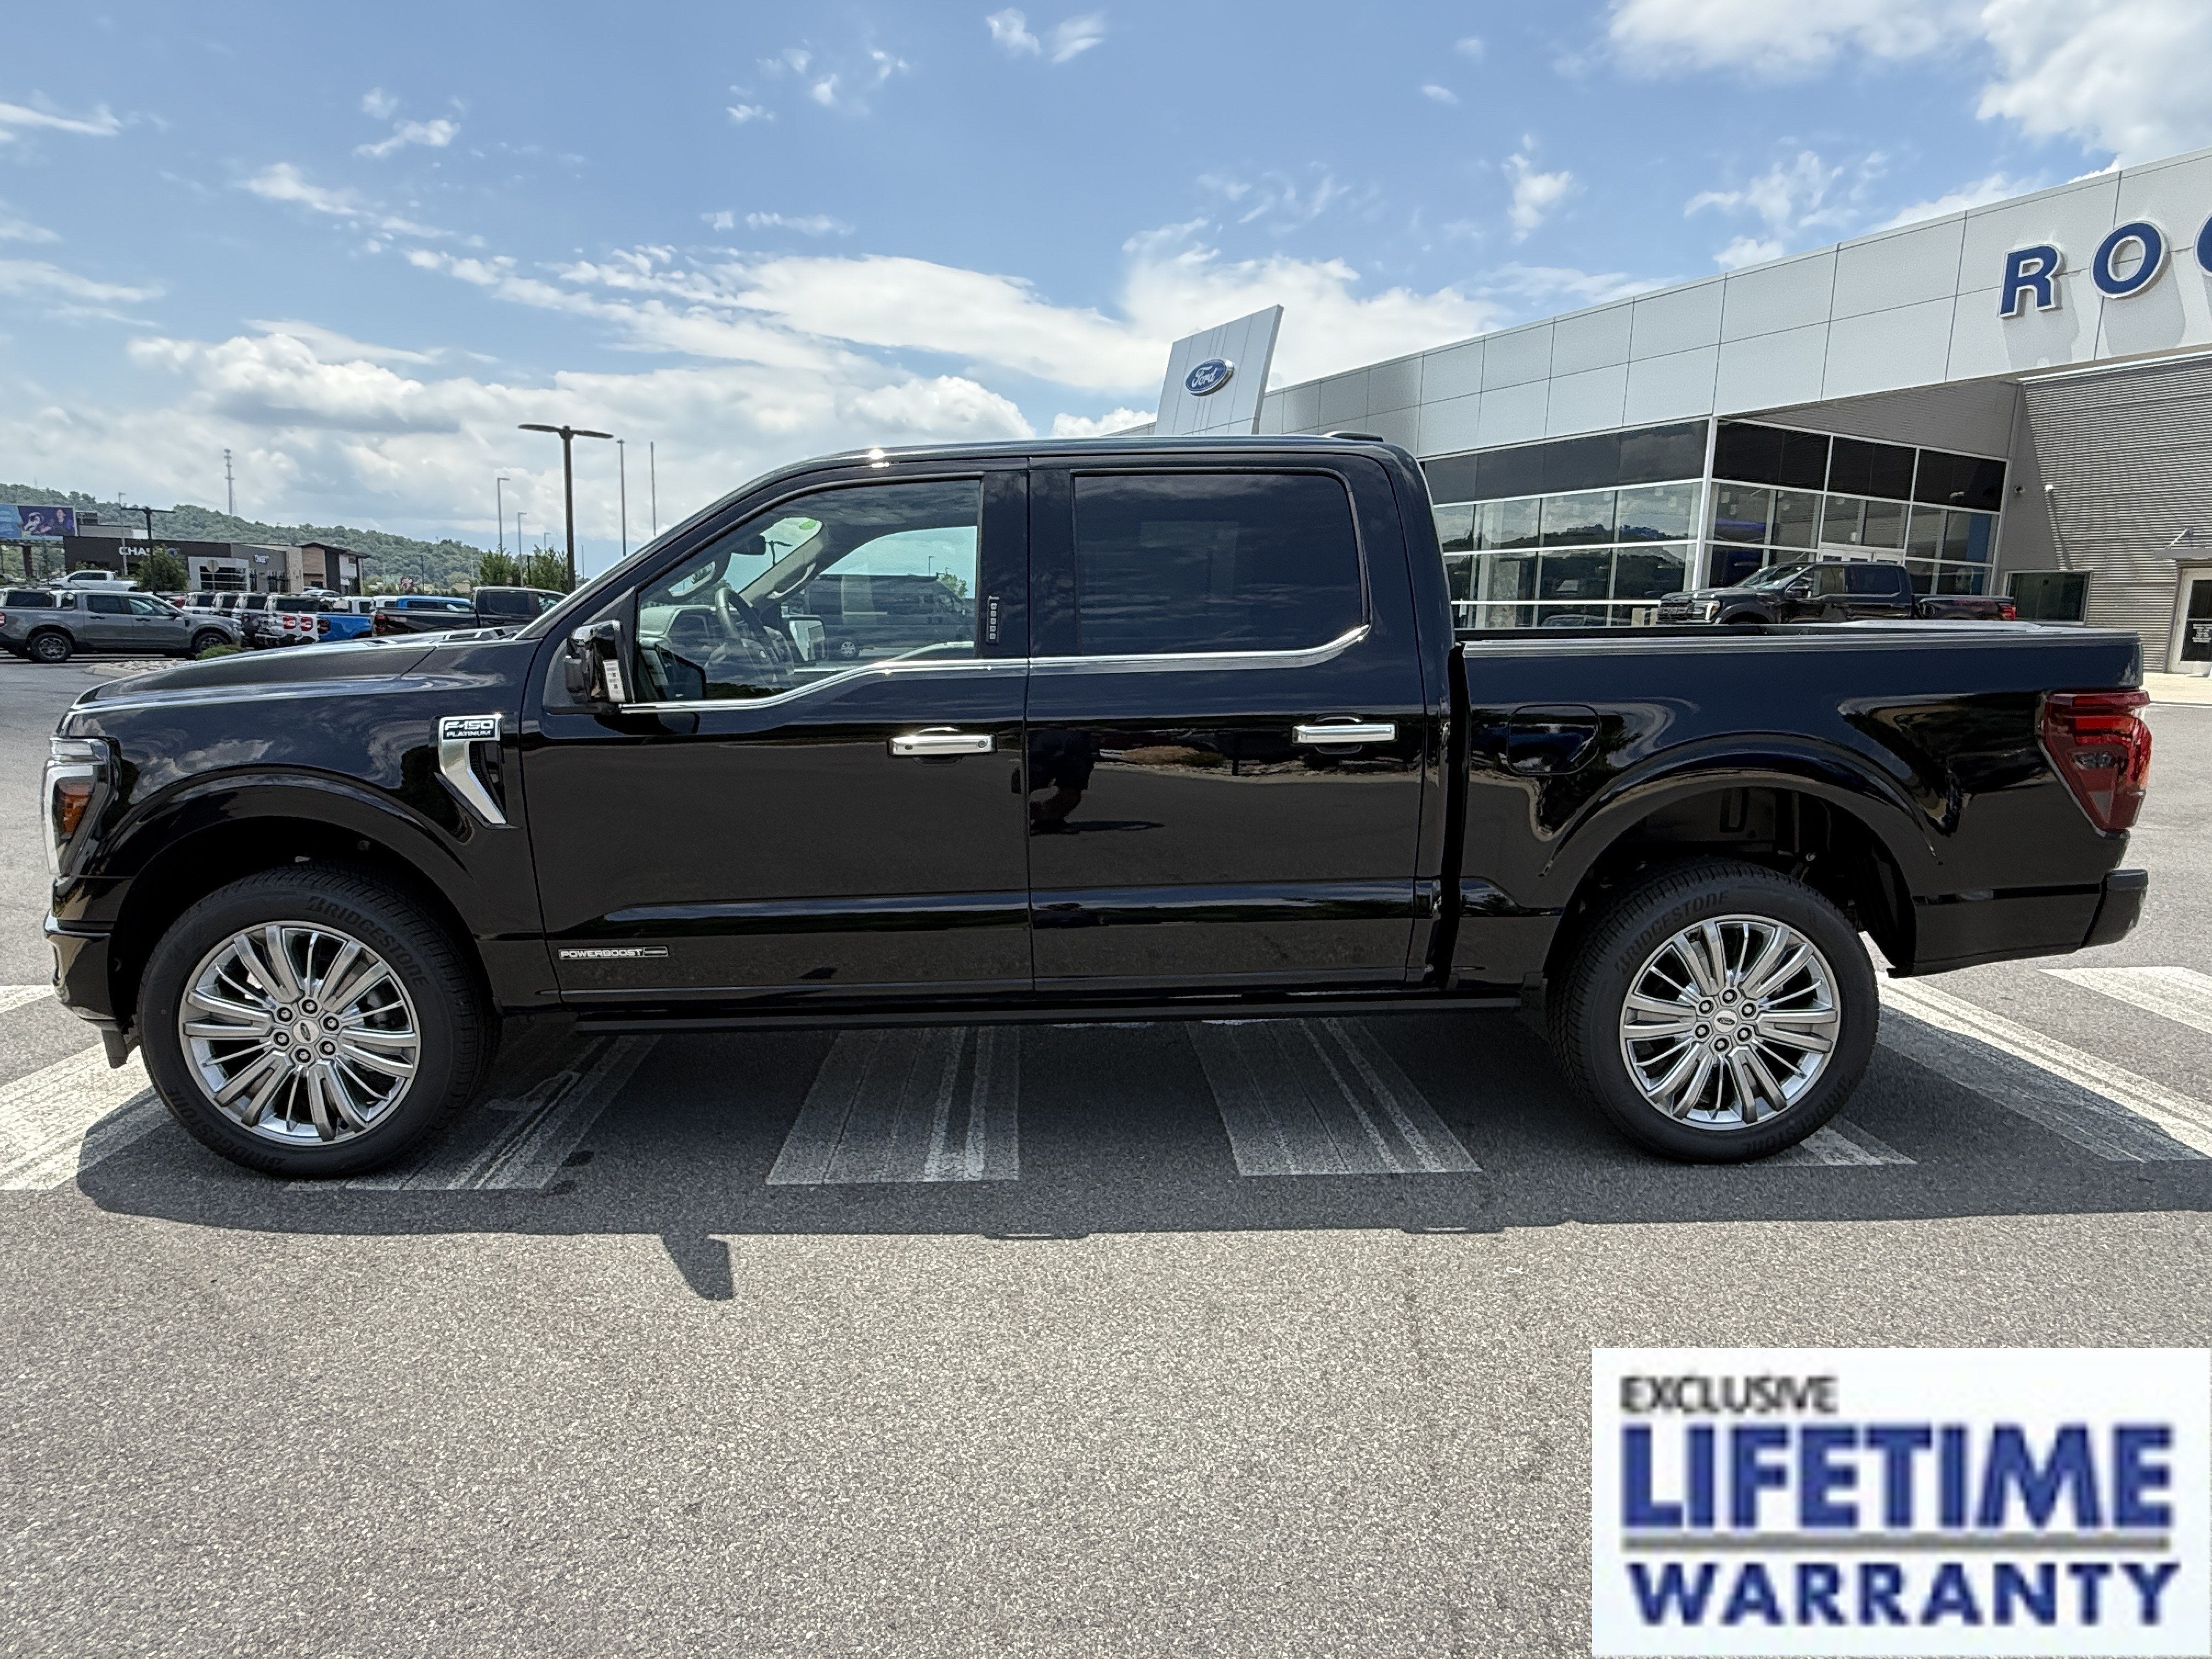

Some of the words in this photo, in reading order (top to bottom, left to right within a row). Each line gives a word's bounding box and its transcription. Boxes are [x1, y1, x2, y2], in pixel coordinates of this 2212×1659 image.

[1997, 210, 2212, 318] RO
[1192, 365, 1218, 388] Ford
[444, 720, 494, 731] F-150
[306, 895, 430, 988] BRIDGESTONE
[561, 949, 643, 958] POWERBOOST
[1614, 890, 1728, 974] BRIDGESTONE
